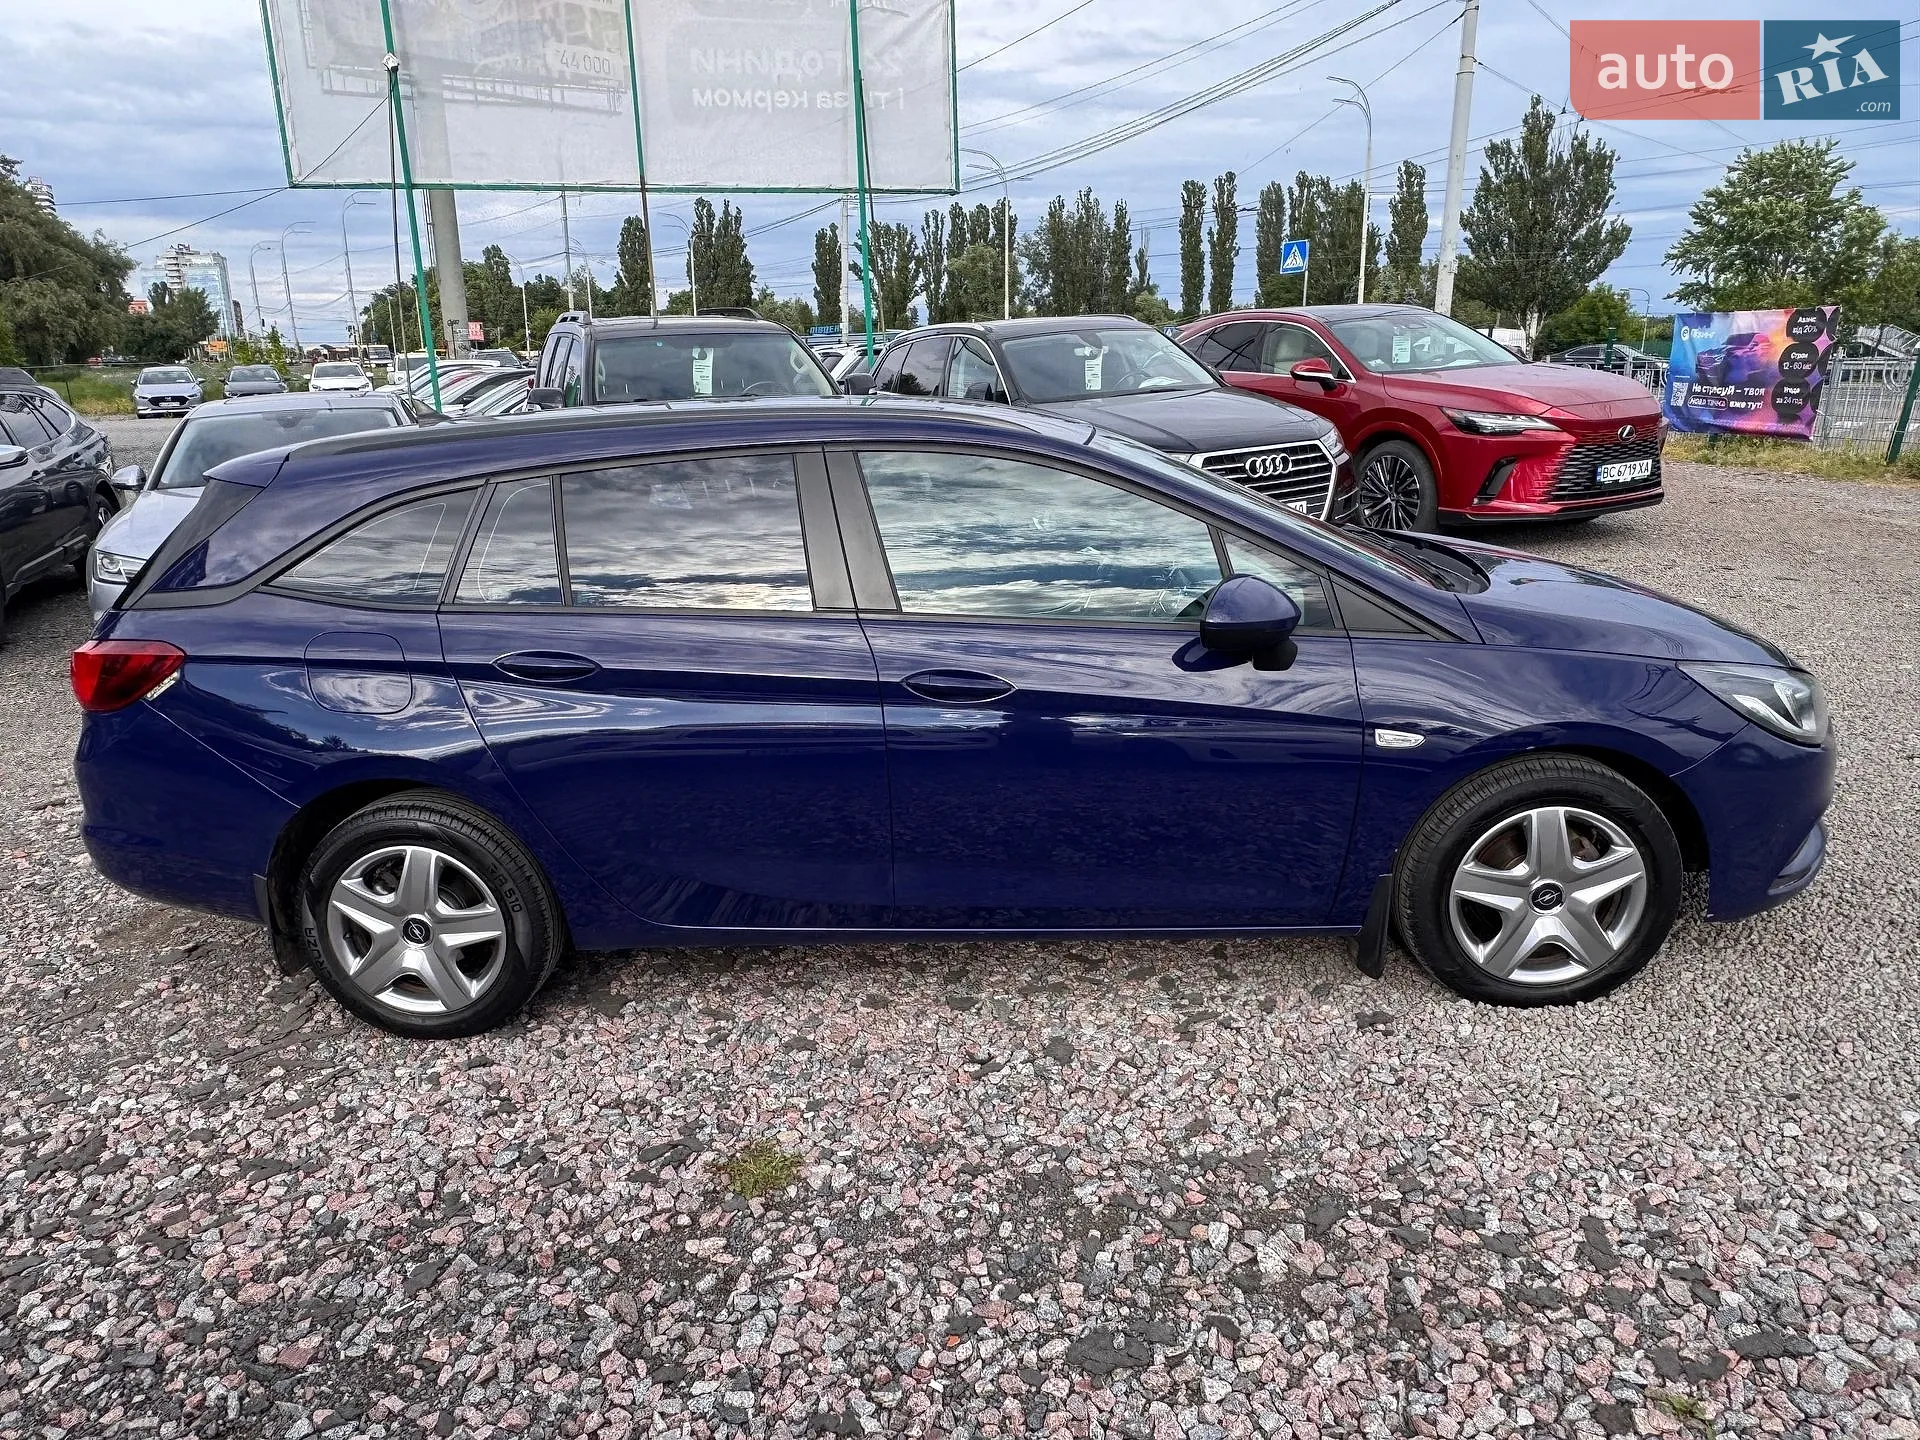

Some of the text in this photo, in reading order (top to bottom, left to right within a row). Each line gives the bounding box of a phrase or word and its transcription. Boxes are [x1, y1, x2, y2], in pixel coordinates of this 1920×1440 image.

[1692, 383, 1702, 393] Не
[1743, 387, 1766, 396] твоя
[1729, 400, 1747, 409] вже
[1602, 461, 1649, 479] BC 6719 XA
